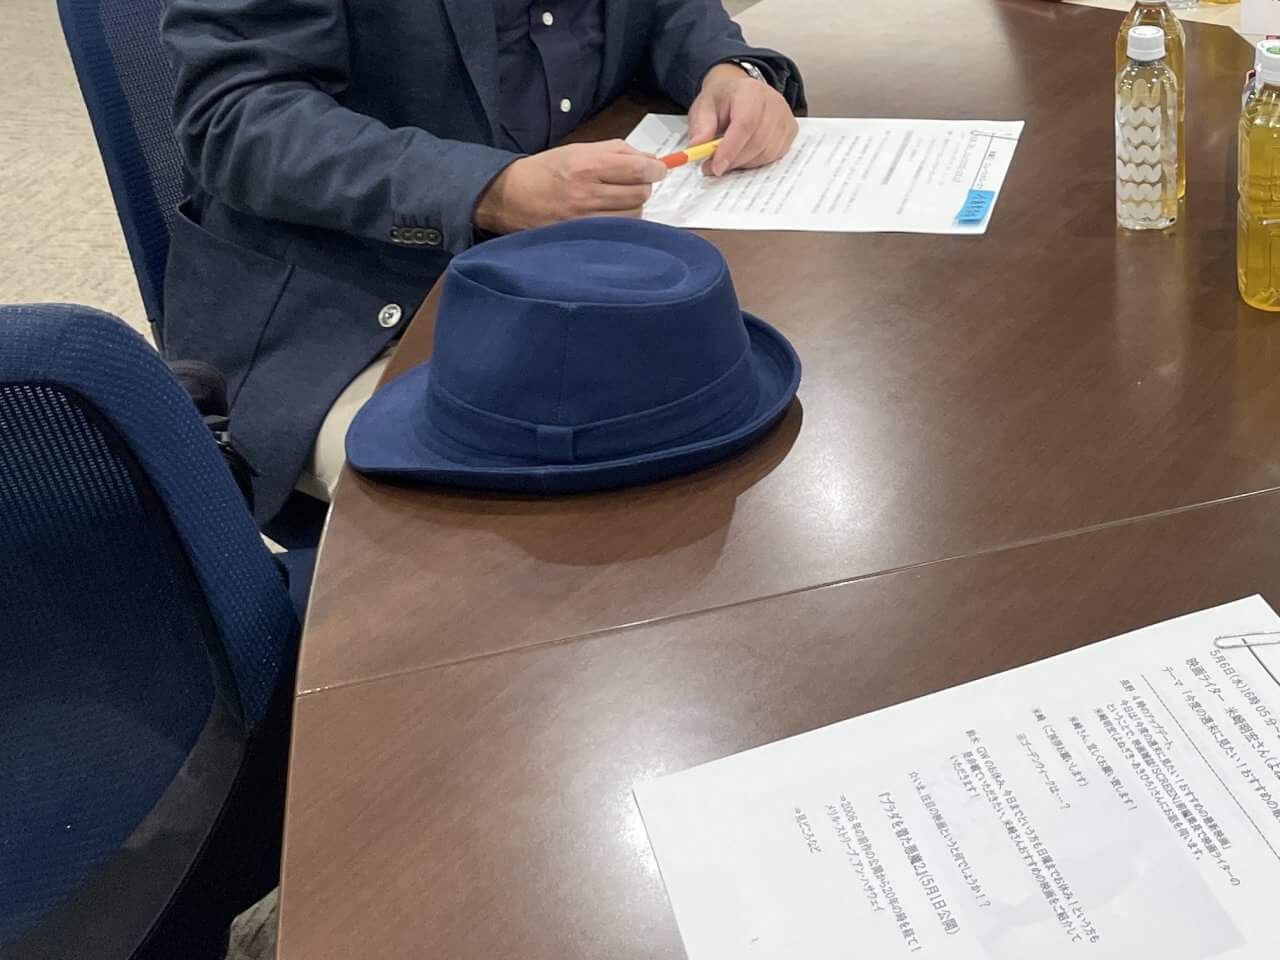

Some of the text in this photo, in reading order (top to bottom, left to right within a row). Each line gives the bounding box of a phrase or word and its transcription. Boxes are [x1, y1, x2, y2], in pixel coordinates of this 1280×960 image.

[1159, 665, 1185, 687] テーマ
[1182, 657, 1228, 703] 映画ライター
